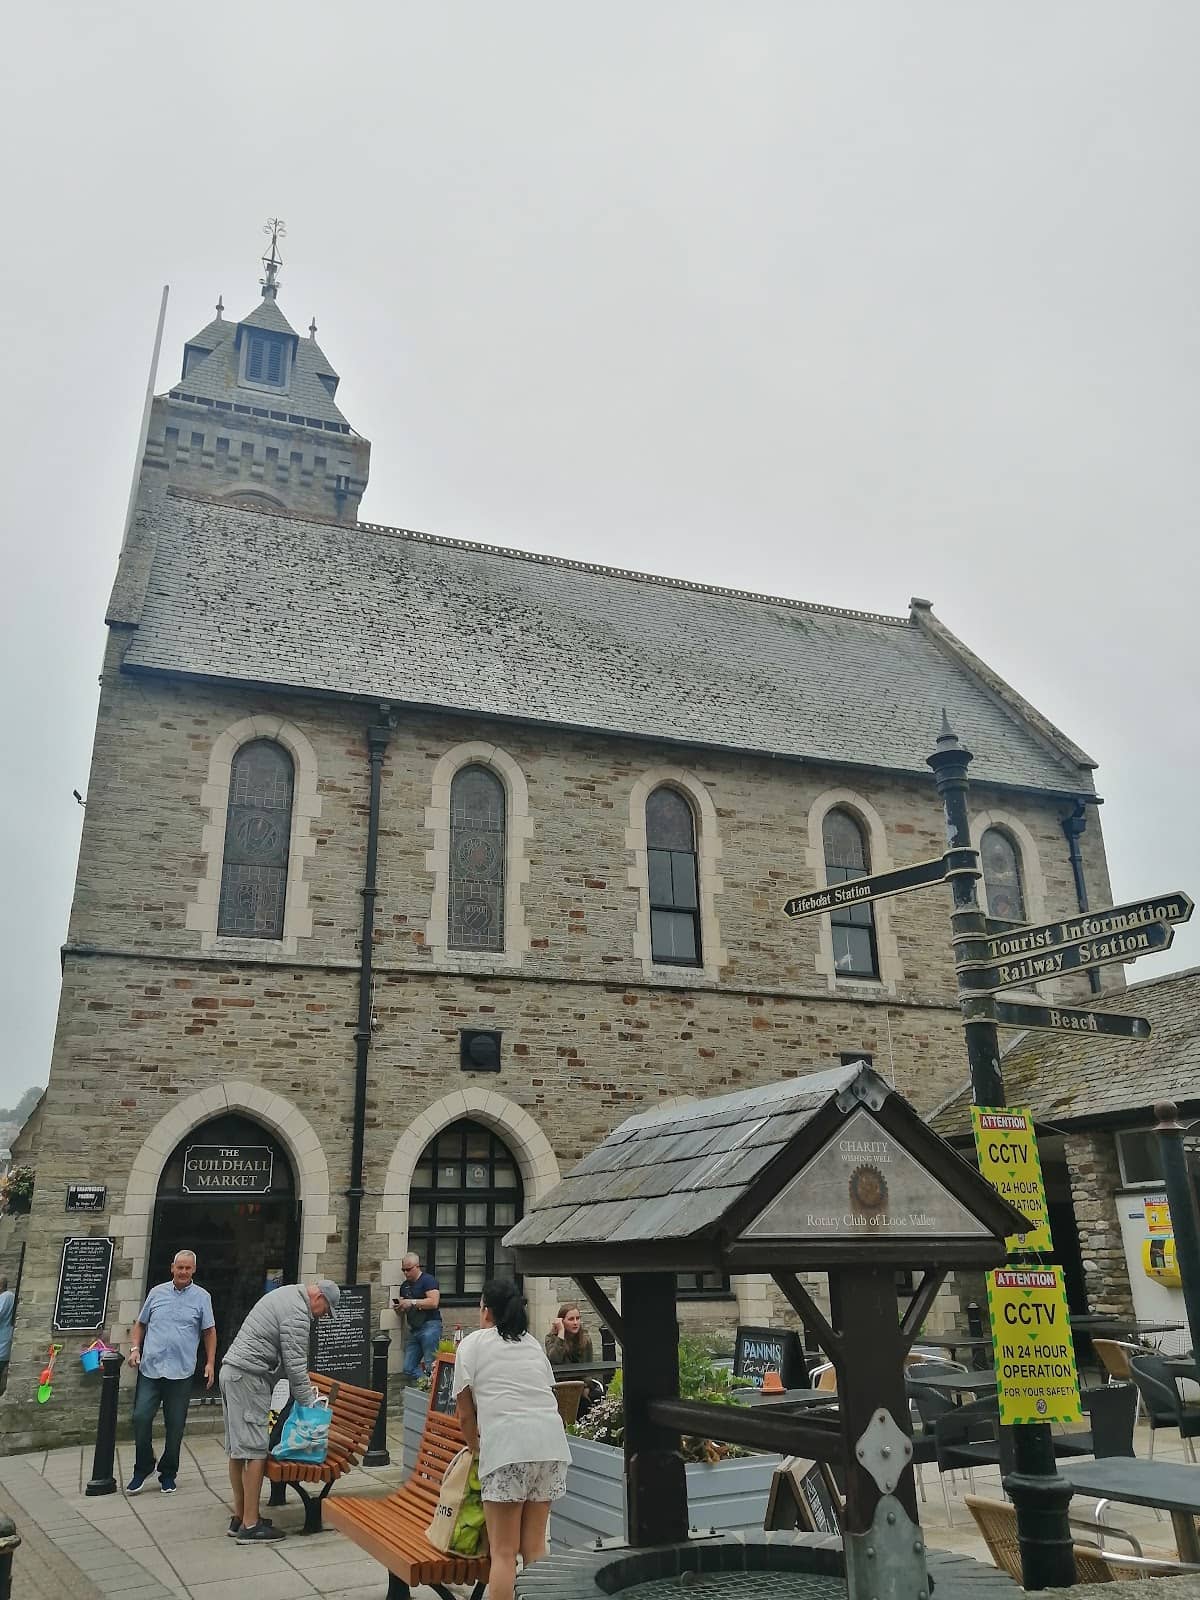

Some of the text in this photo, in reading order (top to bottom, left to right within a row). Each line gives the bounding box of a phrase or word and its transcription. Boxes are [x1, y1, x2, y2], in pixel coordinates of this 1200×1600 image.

[791, 885, 871, 914] Lifeboat Station
[988, 903, 1180, 958] Tourist Information
[998, 933, 1149, 985] Railway Station
[1050, 1011, 1098, 1031] Beach
[982, 1116, 1026, 1129] ATTENTION
[219, 1149, 240, 1157] THE
[840, 1140, 887, 1152] CHARITY
[842, 1154, 892, 1163] WISHING WELL
[988, 1143, 1028, 1164] CCTV
[187, 1160, 270, 1171] GUILDHALL
[197, 1175, 258, 1186] MARKET
[1001, 1182, 1011, 1193] 24
[1013, 1181, 1039, 1194] HOUR
[1007, 1199, 1042, 1211] RATION
[807, 1214, 840, 1229] Rotary
[843, 1214, 867, 1226] Club
[869, 1214, 881, 1226] of
[909, 1214, 937, 1229] Valley
[997, 1271, 1055, 1286] ATTENTION
[1004, 1302, 1055, 1325] CCTV
[744, 1337, 781, 1361] PANINIS
[1002, 1345, 1068, 1358] IN 24 HOUR
[1003, 1363, 1071, 1378] OPERATION
[1004, 1386, 1074, 1397] FOR YOUR SAFETY
